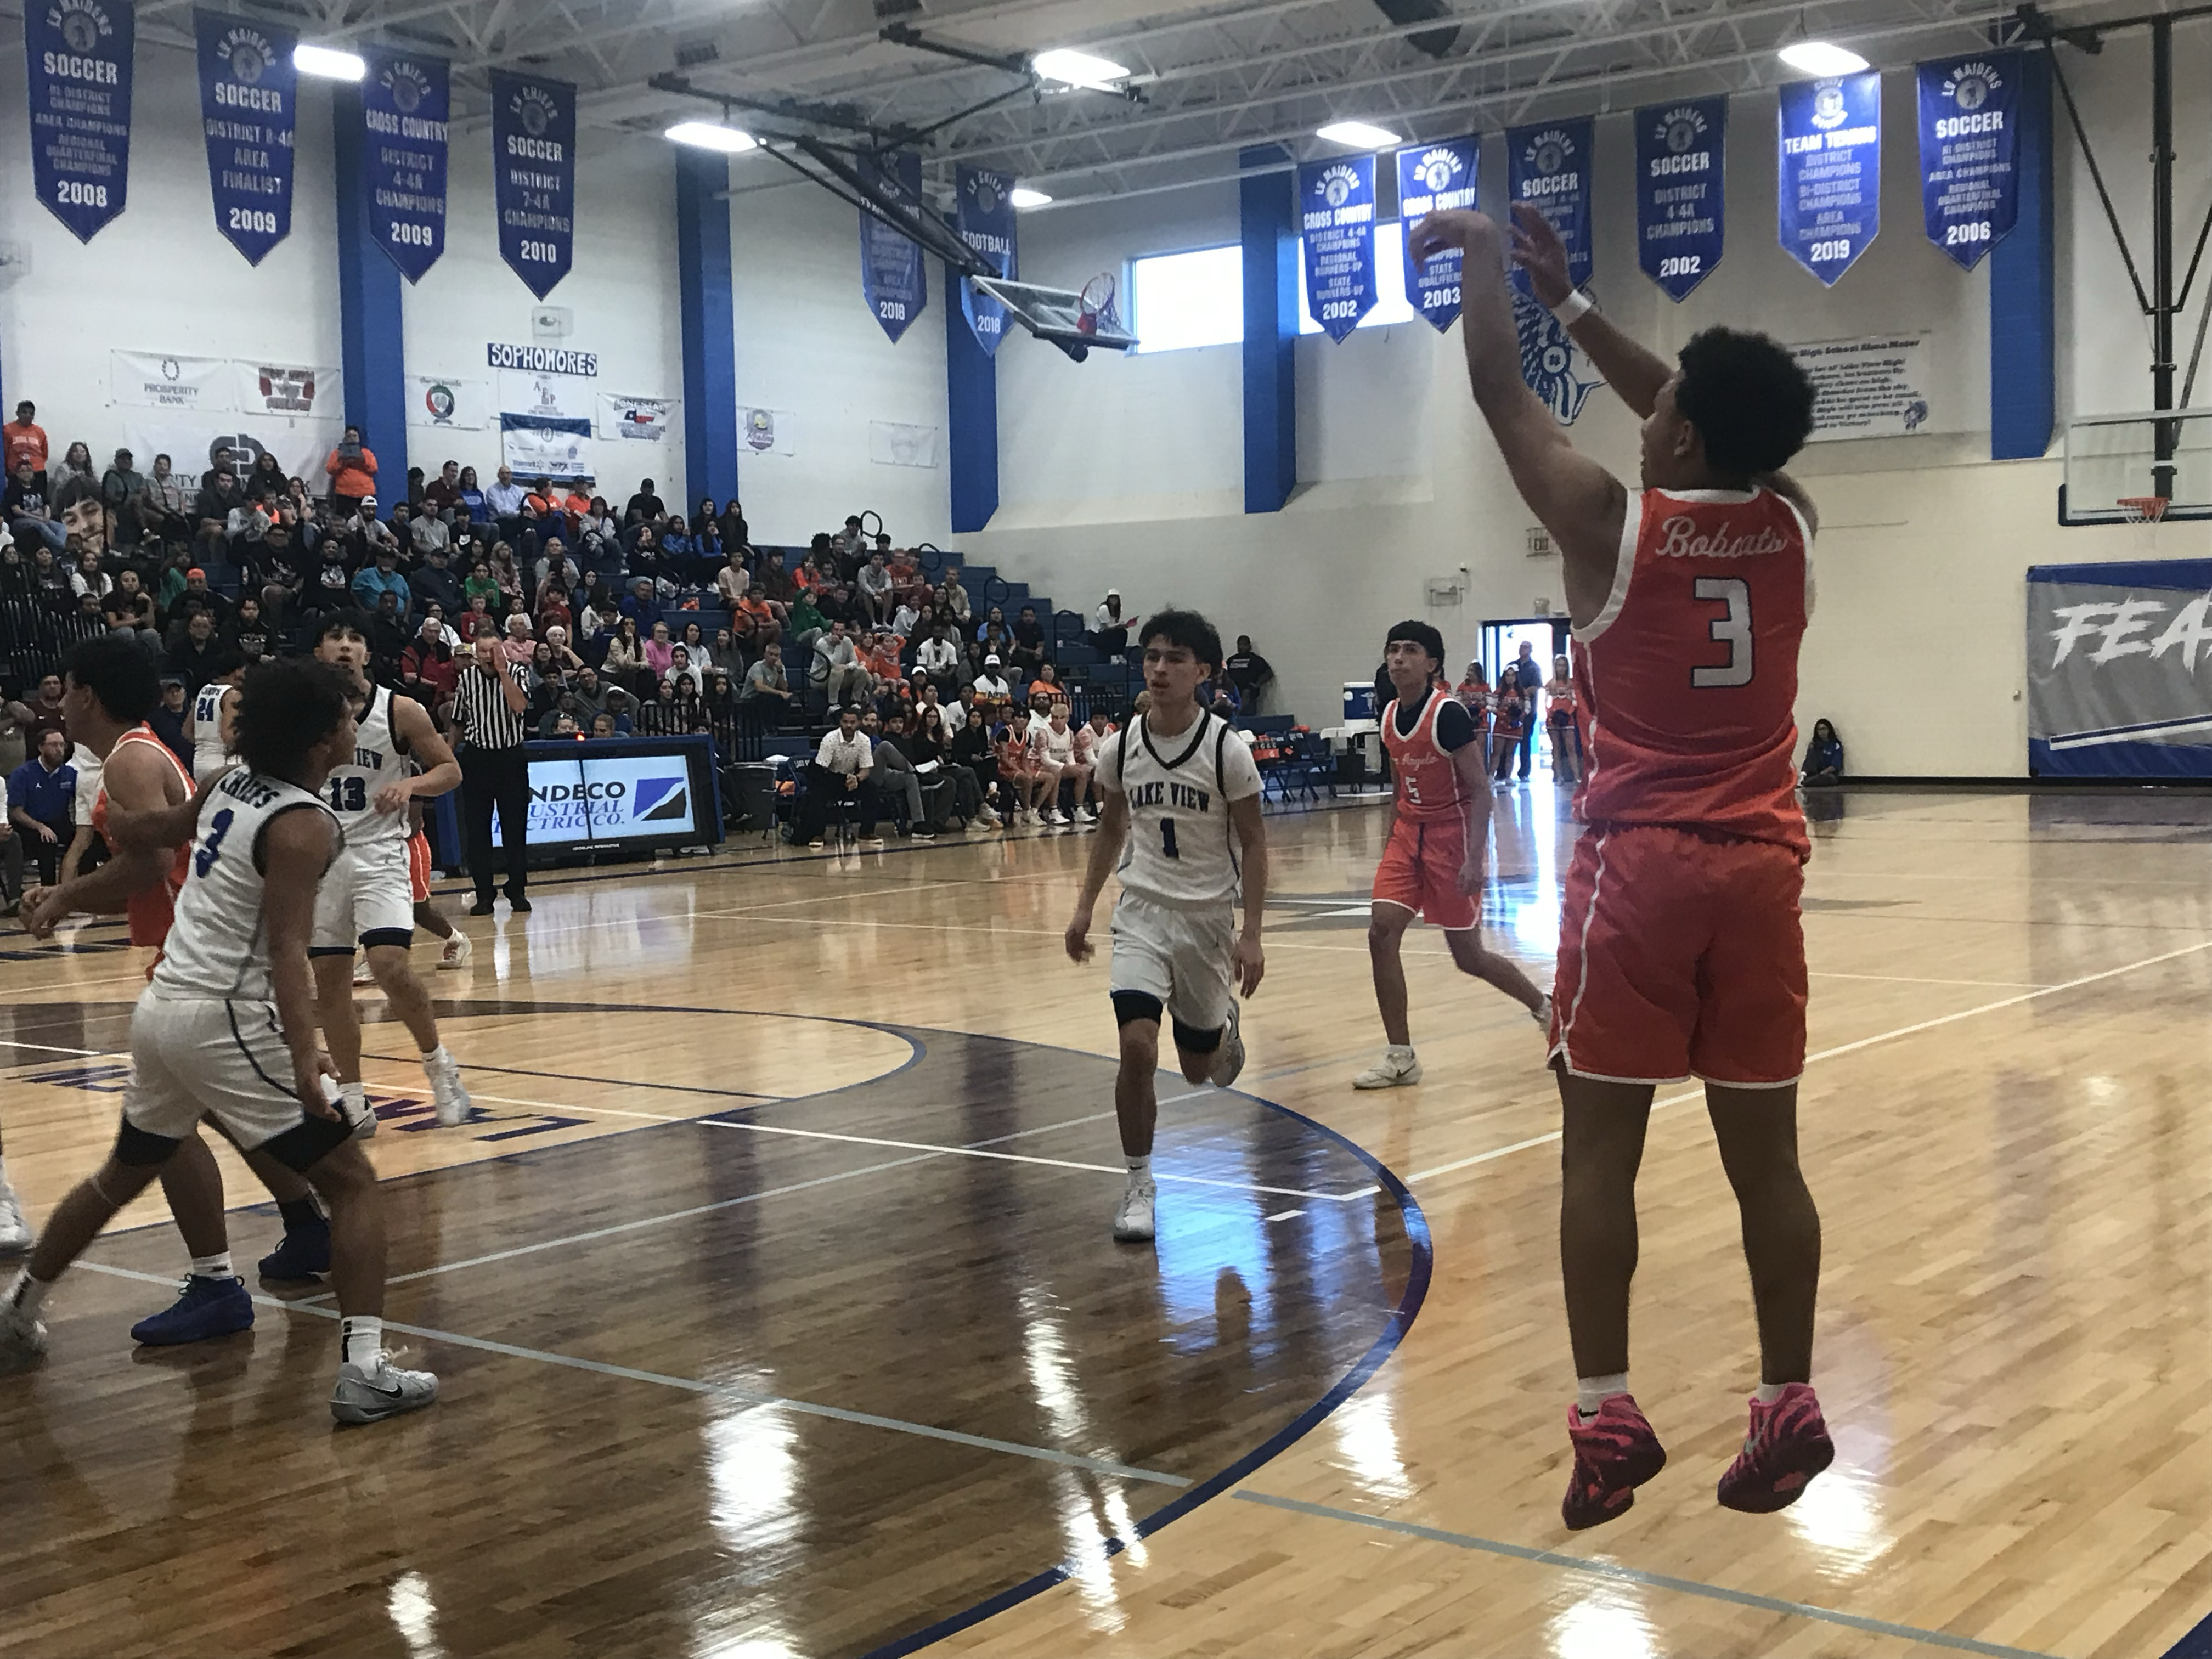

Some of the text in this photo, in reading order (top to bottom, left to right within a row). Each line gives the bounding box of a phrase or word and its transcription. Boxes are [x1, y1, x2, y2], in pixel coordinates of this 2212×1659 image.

[44, 52, 117, 84] SOCCER
[1953, 61, 2003, 89] MAIDENS
[215, 82, 282, 113] SOCCER
[206, 119, 260, 142] DISTRICT
[366, 108, 448, 142] CROSS COUNTRY
[1936, 111, 2004, 139] SOCCER
[507, 135, 562, 162] SOCCER
[1784, 133, 1822, 154] TEAM
[234, 147, 268, 169] AREA
[381, 146, 433, 171] DISTRICT
[1651, 152, 1709, 177] SOCCER
[1805, 149, 1853, 167] DISTRICT
[1956, 162, 2011, 179] CHAMPIONS
[222, 170, 281, 195] FINALIST
[510, 169, 561, 191] DISTRICT
[1522, 172, 1578, 197] SOCCER
[1798, 162, 1861, 182] CHAMPIONS
[57, 180, 108, 207] 2008
[376, 187, 444, 215] CHAMPIONS
[1403, 187, 1476, 217] CROSS COUNTRY
[1655, 183, 1707, 204] DISTRICT
[1799, 192, 1861, 211] CHAMPIONS
[229, 207, 276, 233] 2009
[505, 208, 570, 233] CHAMPIONS
[1304, 203, 1372, 230] CROSS COUNTRY
[1647, 218, 1714, 240] CHAMPIONS
[391, 221, 432, 246] 2009
[962, 230, 1011, 255] FOOTBALL
[1799, 222, 1861, 240] CHAMPIONS
[1946, 221, 1991, 246] 2006
[521, 240, 556, 263] 2010
[1810, 239, 1850, 262] 2019
[1429, 262, 1453, 275] STATE
[1660, 256, 1700, 278] 2002
[880, 301, 905, 320] 2018
[1323, 300, 1357, 320] 2002
[1424, 287, 1462, 309] 2003
[978, 315, 1001, 334] 2018
[492, 344, 596, 375] SOPHOMORES
[144, 382, 199, 397] PROSPERITY
[159, 394, 185, 405] BANK
[1655, 516, 1787, 558] Bobcats
[1691, 576, 1754, 688] 3
[2048, 590, 2212, 678] FEA
[354, 747, 383, 771] IEW
[220, 770, 281, 809] CHIEFS
[331, 776, 366, 812] 13
[528, 782, 625, 804] NDECO
[1129, 781, 1210, 813] LAKE VIEW
[1405, 776, 1422, 804] 5
[530, 800, 624, 818] USTRIAL
[527, 812, 625, 832] CTRIC CO.
[195, 808, 235, 879] 3
[1160, 817, 1180, 859] 1
